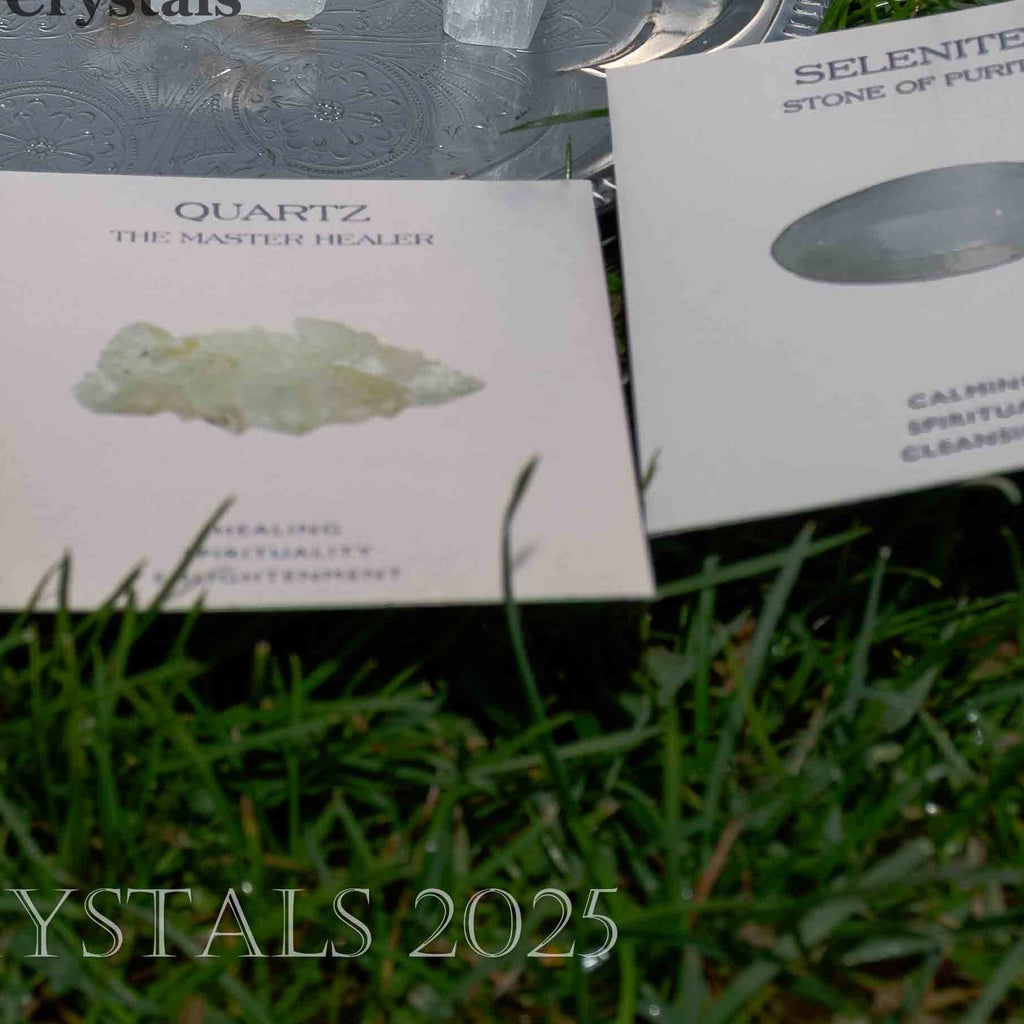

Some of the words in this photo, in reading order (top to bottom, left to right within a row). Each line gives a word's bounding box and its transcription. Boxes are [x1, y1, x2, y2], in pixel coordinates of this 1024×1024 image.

[794, 27, 1024, 85] SELENITE
[783, 84, 886, 114] STONE
[895, 75, 936, 95] OF
[174, 201, 371, 223] QUARTZ
[110, 230, 170, 244] THE
[180, 231, 304, 246] MASTER
[315, 233, 435, 246] HEALER
[907, 374, 1024, 410] CALMIN
